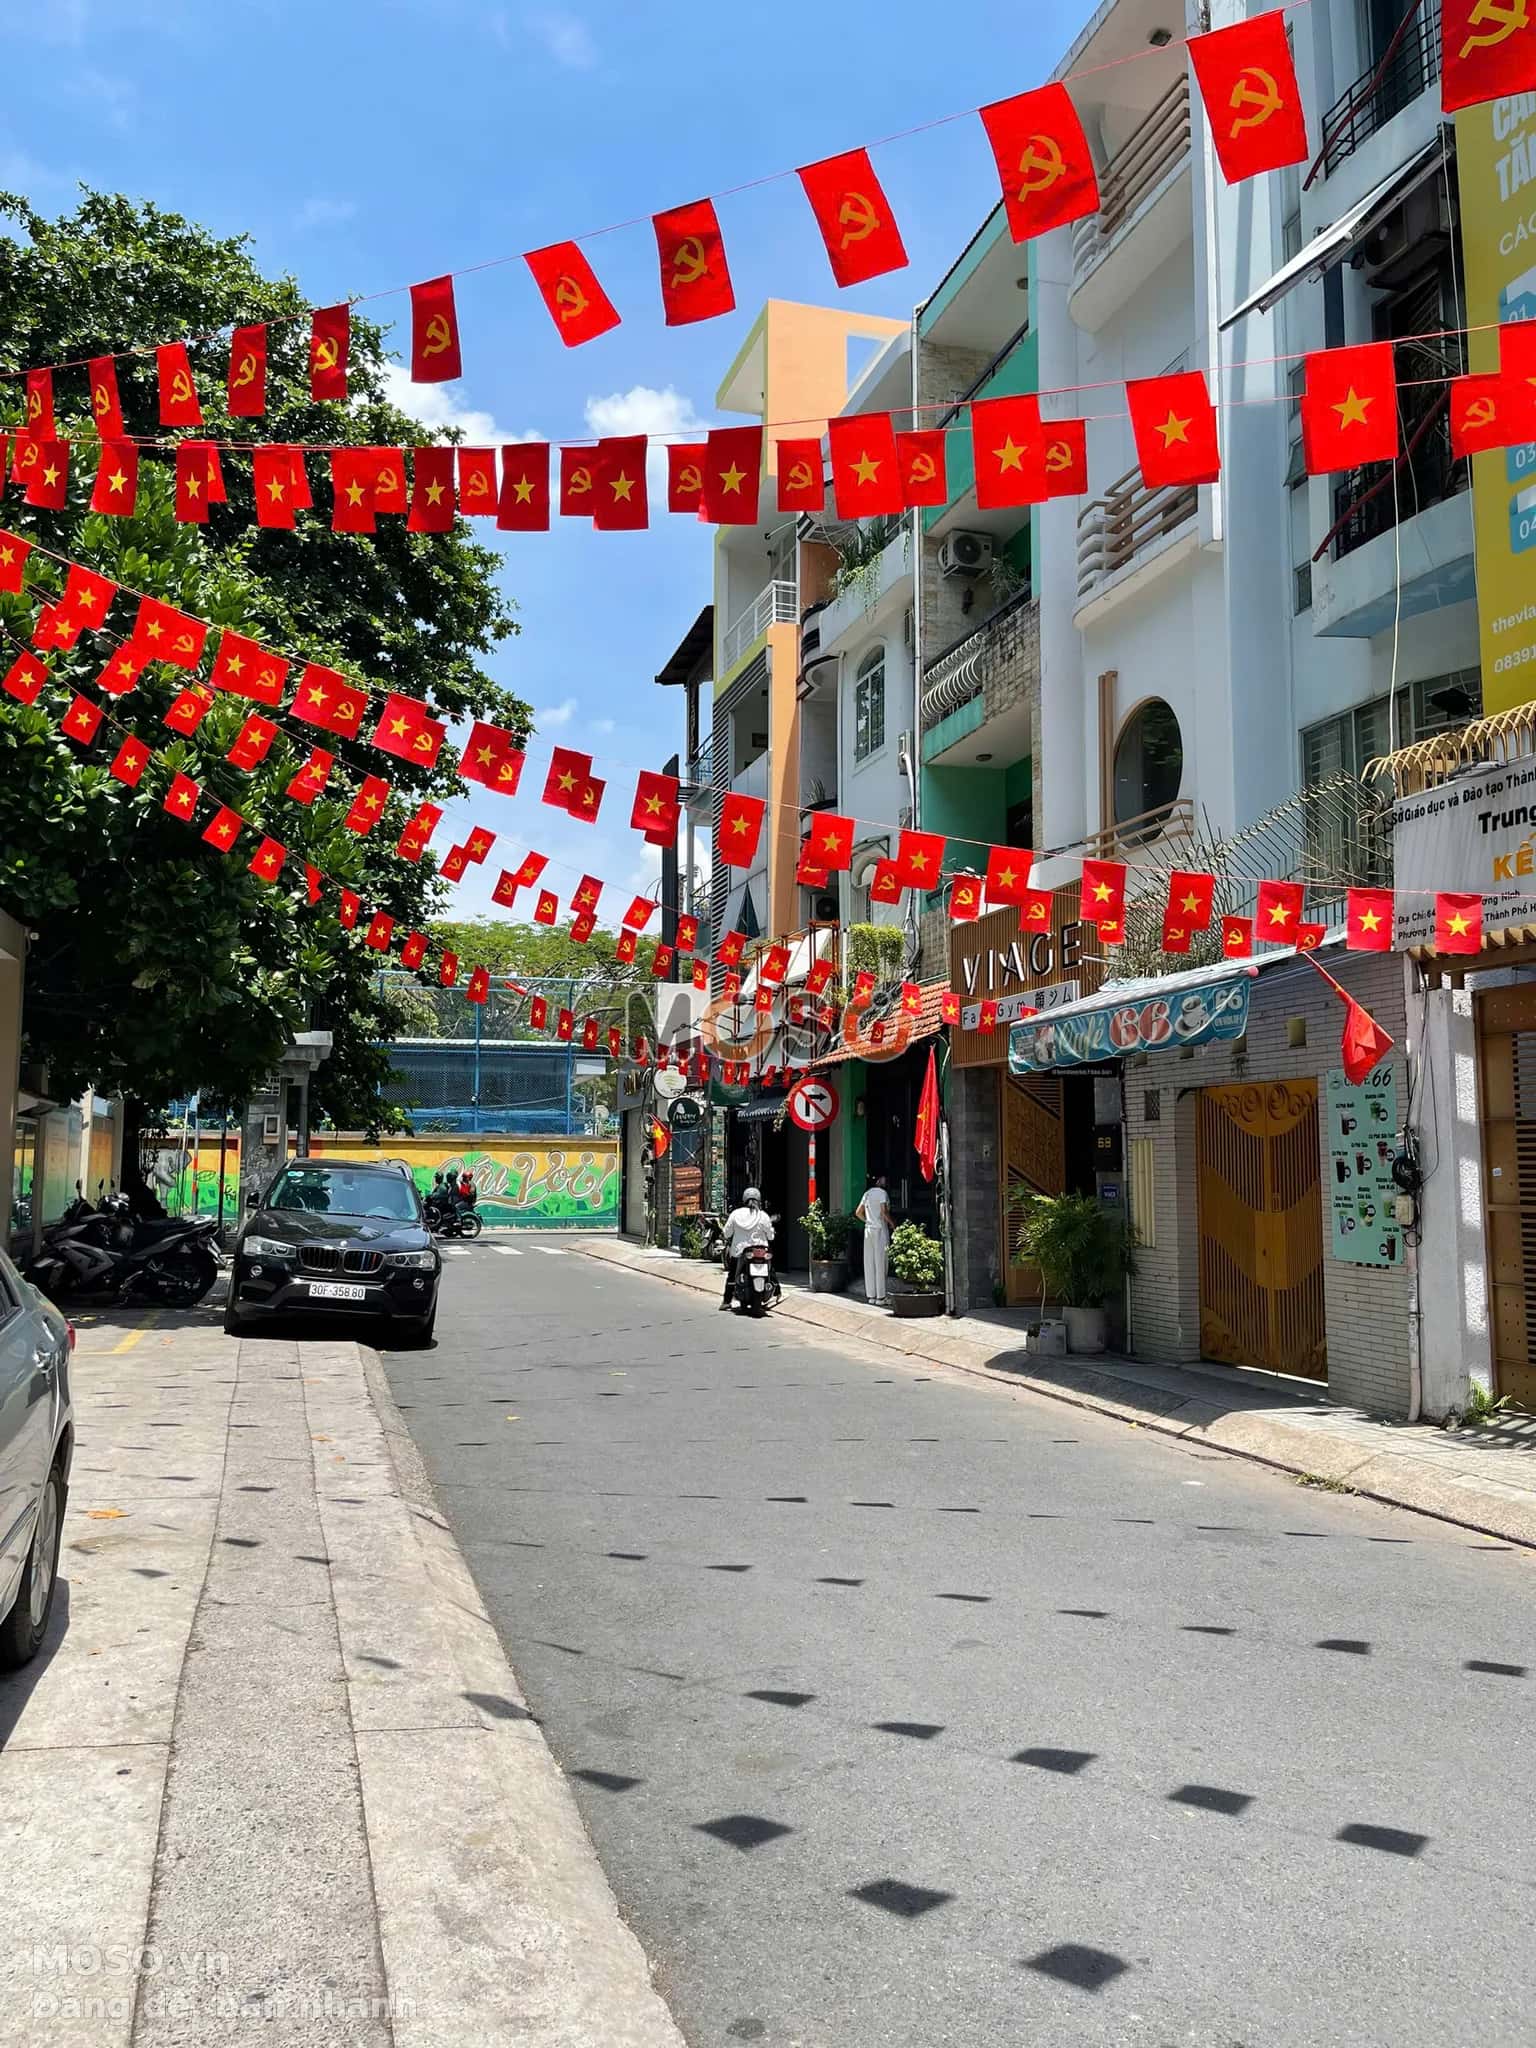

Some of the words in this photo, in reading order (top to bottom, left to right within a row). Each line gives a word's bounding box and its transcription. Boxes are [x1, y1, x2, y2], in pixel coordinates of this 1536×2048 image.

[1428, 800, 1446, 817] dục
[1448, 793, 1460, 808] và
[1463, 787, 1483, 803] Đào
[1486, 781, 1503, 798] tạo
[962, 920, 1082, 995] VIAGE
